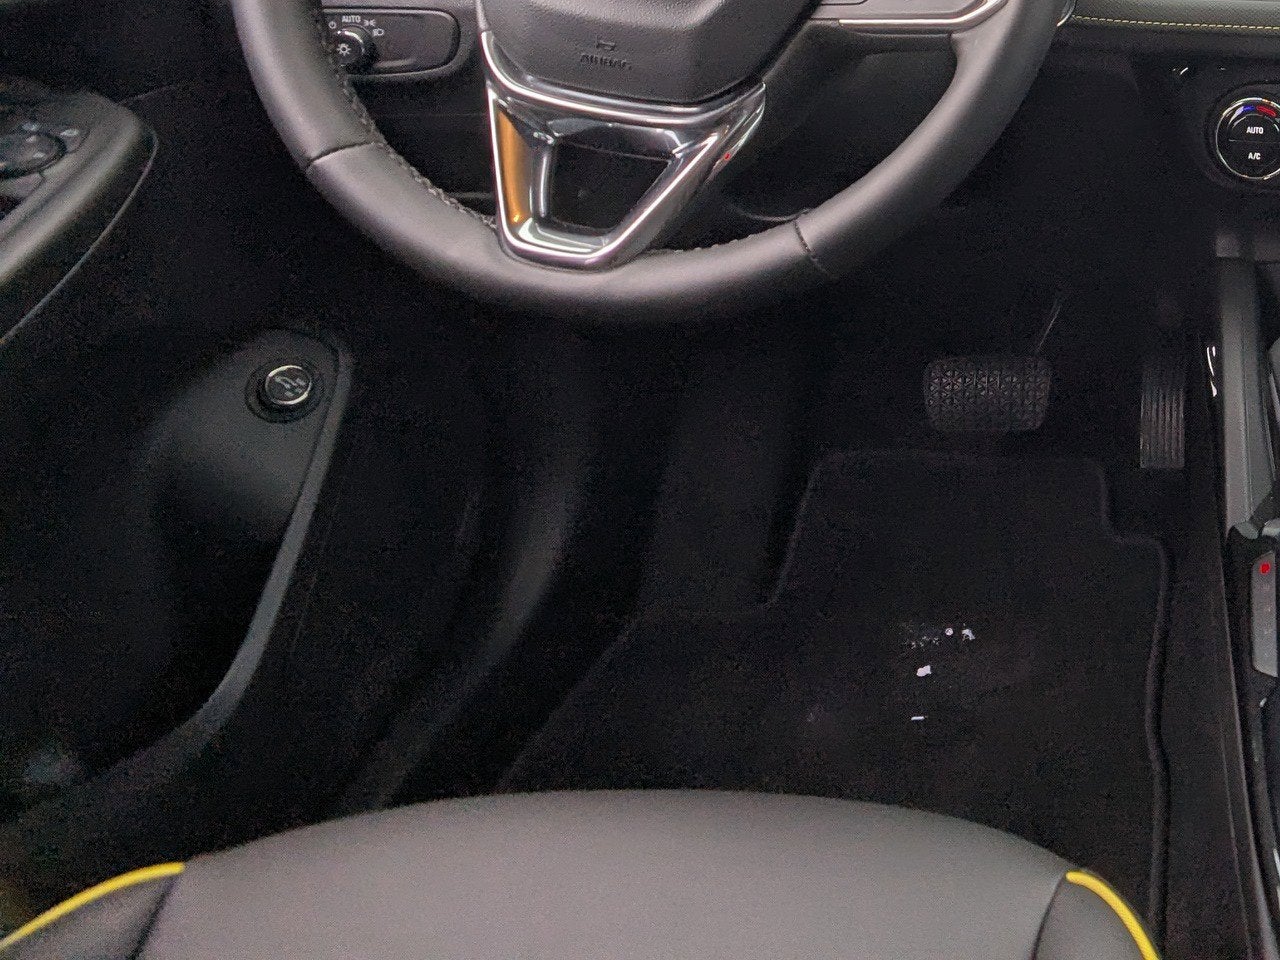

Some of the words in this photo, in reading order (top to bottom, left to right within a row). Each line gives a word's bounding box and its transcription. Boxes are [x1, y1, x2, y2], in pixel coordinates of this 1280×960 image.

[342, 15, 361, 23] AUTO
[1246, 126, 1264, 134] AUTO
[1248, 152, 1261, 160] A/C
